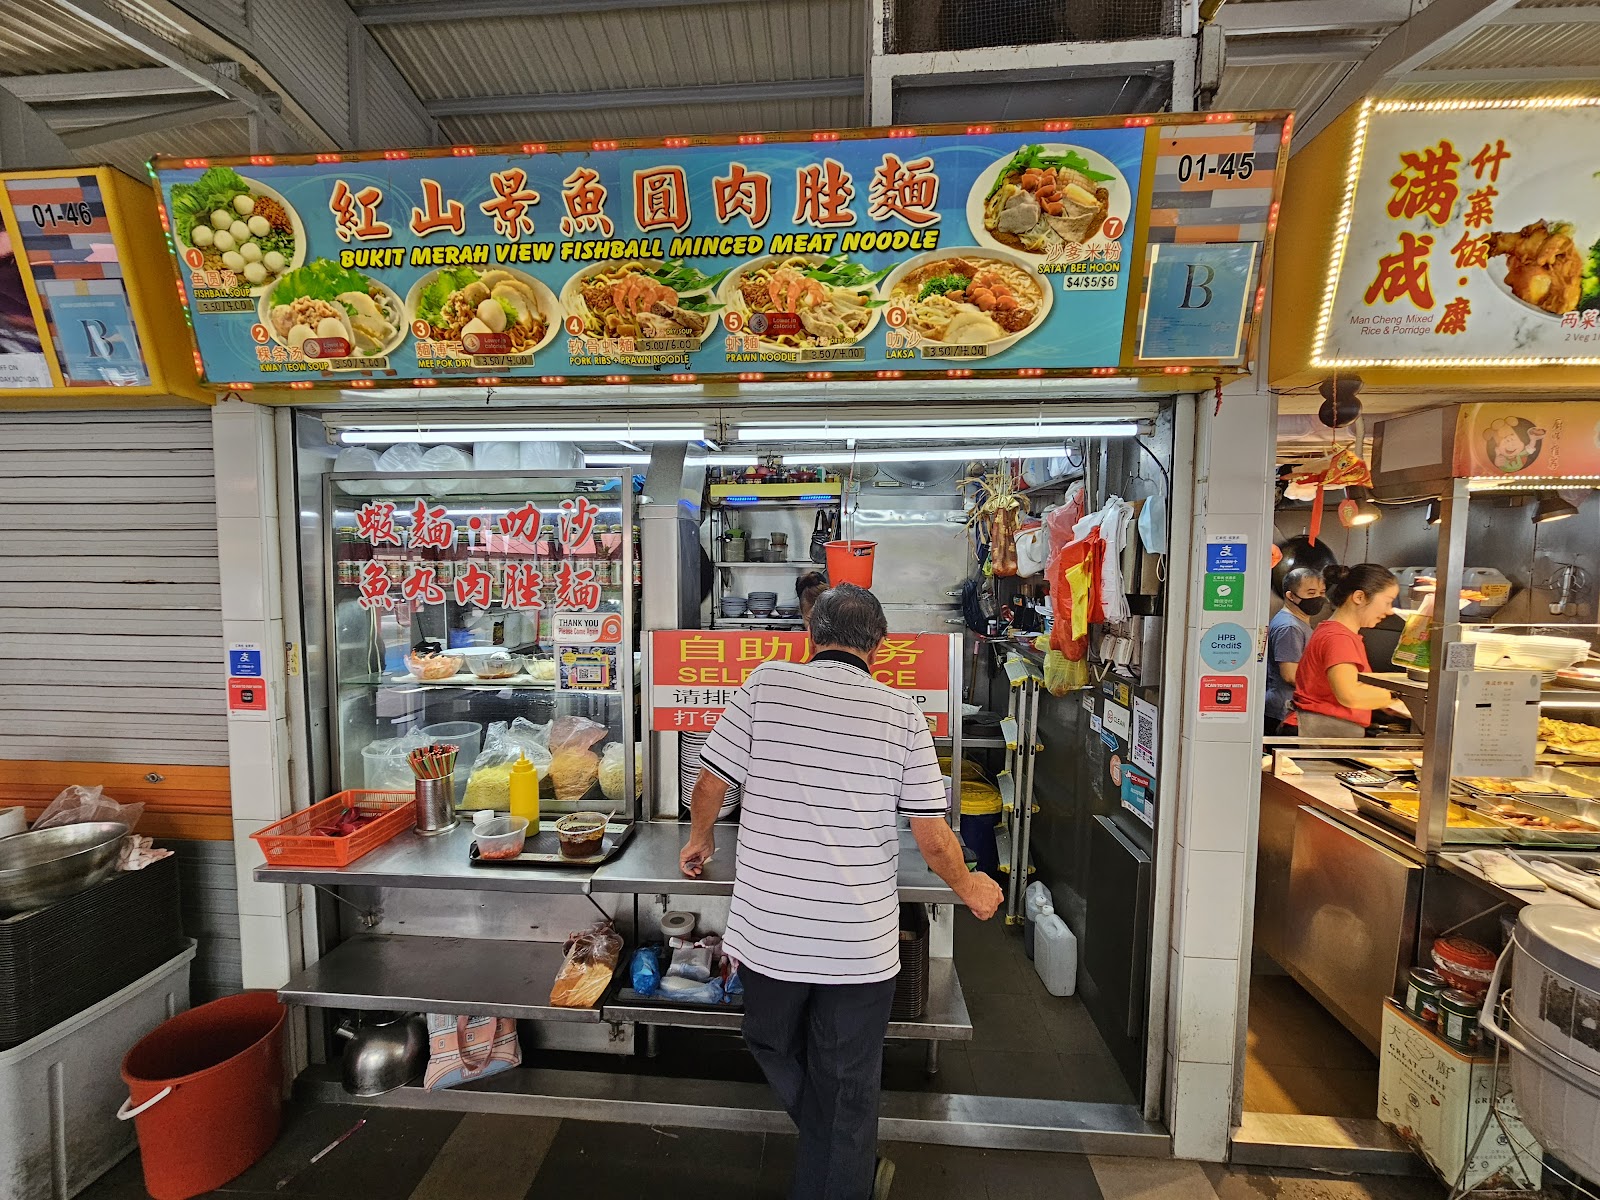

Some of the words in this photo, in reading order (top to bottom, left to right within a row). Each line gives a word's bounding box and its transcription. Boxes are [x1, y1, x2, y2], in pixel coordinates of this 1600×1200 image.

[1178, 151, 1255, 183] 01-45
[32, 202, 92, 227] 01-46
[1109, 220, 1119, 236] 7
[1364, 140, 1461, 310] 满成
[340, 247, 405, 268] BUKIT
[410, 245, 490, 266] MERAH
[495, 242, 555, 264] VIEW
[560, 237, 664, 261] FISHBALL
[670, 235, 764, 258] MINCED
[770, 233, 836, 255] MEAT
[840, 230, 940, 252] NOODLE
[1046, 241, 1122, 262] 沙爹米粉
[1038, 263, 1067, 274] SATAY
[1070, 263, 1086, 273] BEE
[1089, 262, 1120, 272] HOON
[190, 269, 238, 288] 鱼圆汤
[1066, 276, 1115, 288] $4/$5/$6
[194, 289, 228, 298] FISHBALL
[229, 288, 251, 297] SOUP
[1178, 264, 1215, 310] B
[728, 314, 739, 328] 5
[891, 309, 902, 324] 6
[1350, 316, 1370, 325] Man
[1372, 315, 1402, 326] Cheng
[1406, 313, 1434, 323] Mixed
[1561, 310, 1596, 330] 两菜
[416, 322, 425, 335] 3
[569, 318, 579, 332] 4
[1361, 326, 1381, 335] Rice
[1383, 326, 1390, 334] &
[1392, 325, 1431, 336] Porridge
[77, 319, 114, 358] B
[255, 327, 266, 341] 2
[886, 330, 922, 349] 叻沙
[1564, 333, 1571, 341] 2
[1573, 333, 1590, 342] Veg
[567, 337, 635, 355] 软骨虾麵
[725, 335, 760, 352] 虾麵
[255, 345, 303, 362] 粿条汤
[569, 357, 592, 365] PORK
[620, 356, 651, 364] PRAWN
[653, 355, 690, 364] NOODLE
[726, 353, 757, 362] PRAWN
[760, 353, 797, 361] NOODLE
[886, 350, 915, 359] LAKSA
[260, 363, 282, 372] KWAY
[284, 363, 306, 371] TEOW
[307, 362, 329, 370] SOUP
[418, 360, 434, 368] MEE
[436, 359, 453, 367] POK
[455, 359, 472, 367] DRY
[559, 619, 583, 627] THANK
[584, 619, 599, 627] YOU
[587, 628, 599, 636] Again
[680, 635, 924, 666] 自助务
[673, 689, 737, 704] 请排
[1389, 1043, 1418, 1068] GREAT
[1421, 1069, 1447, 1091] CHEF
